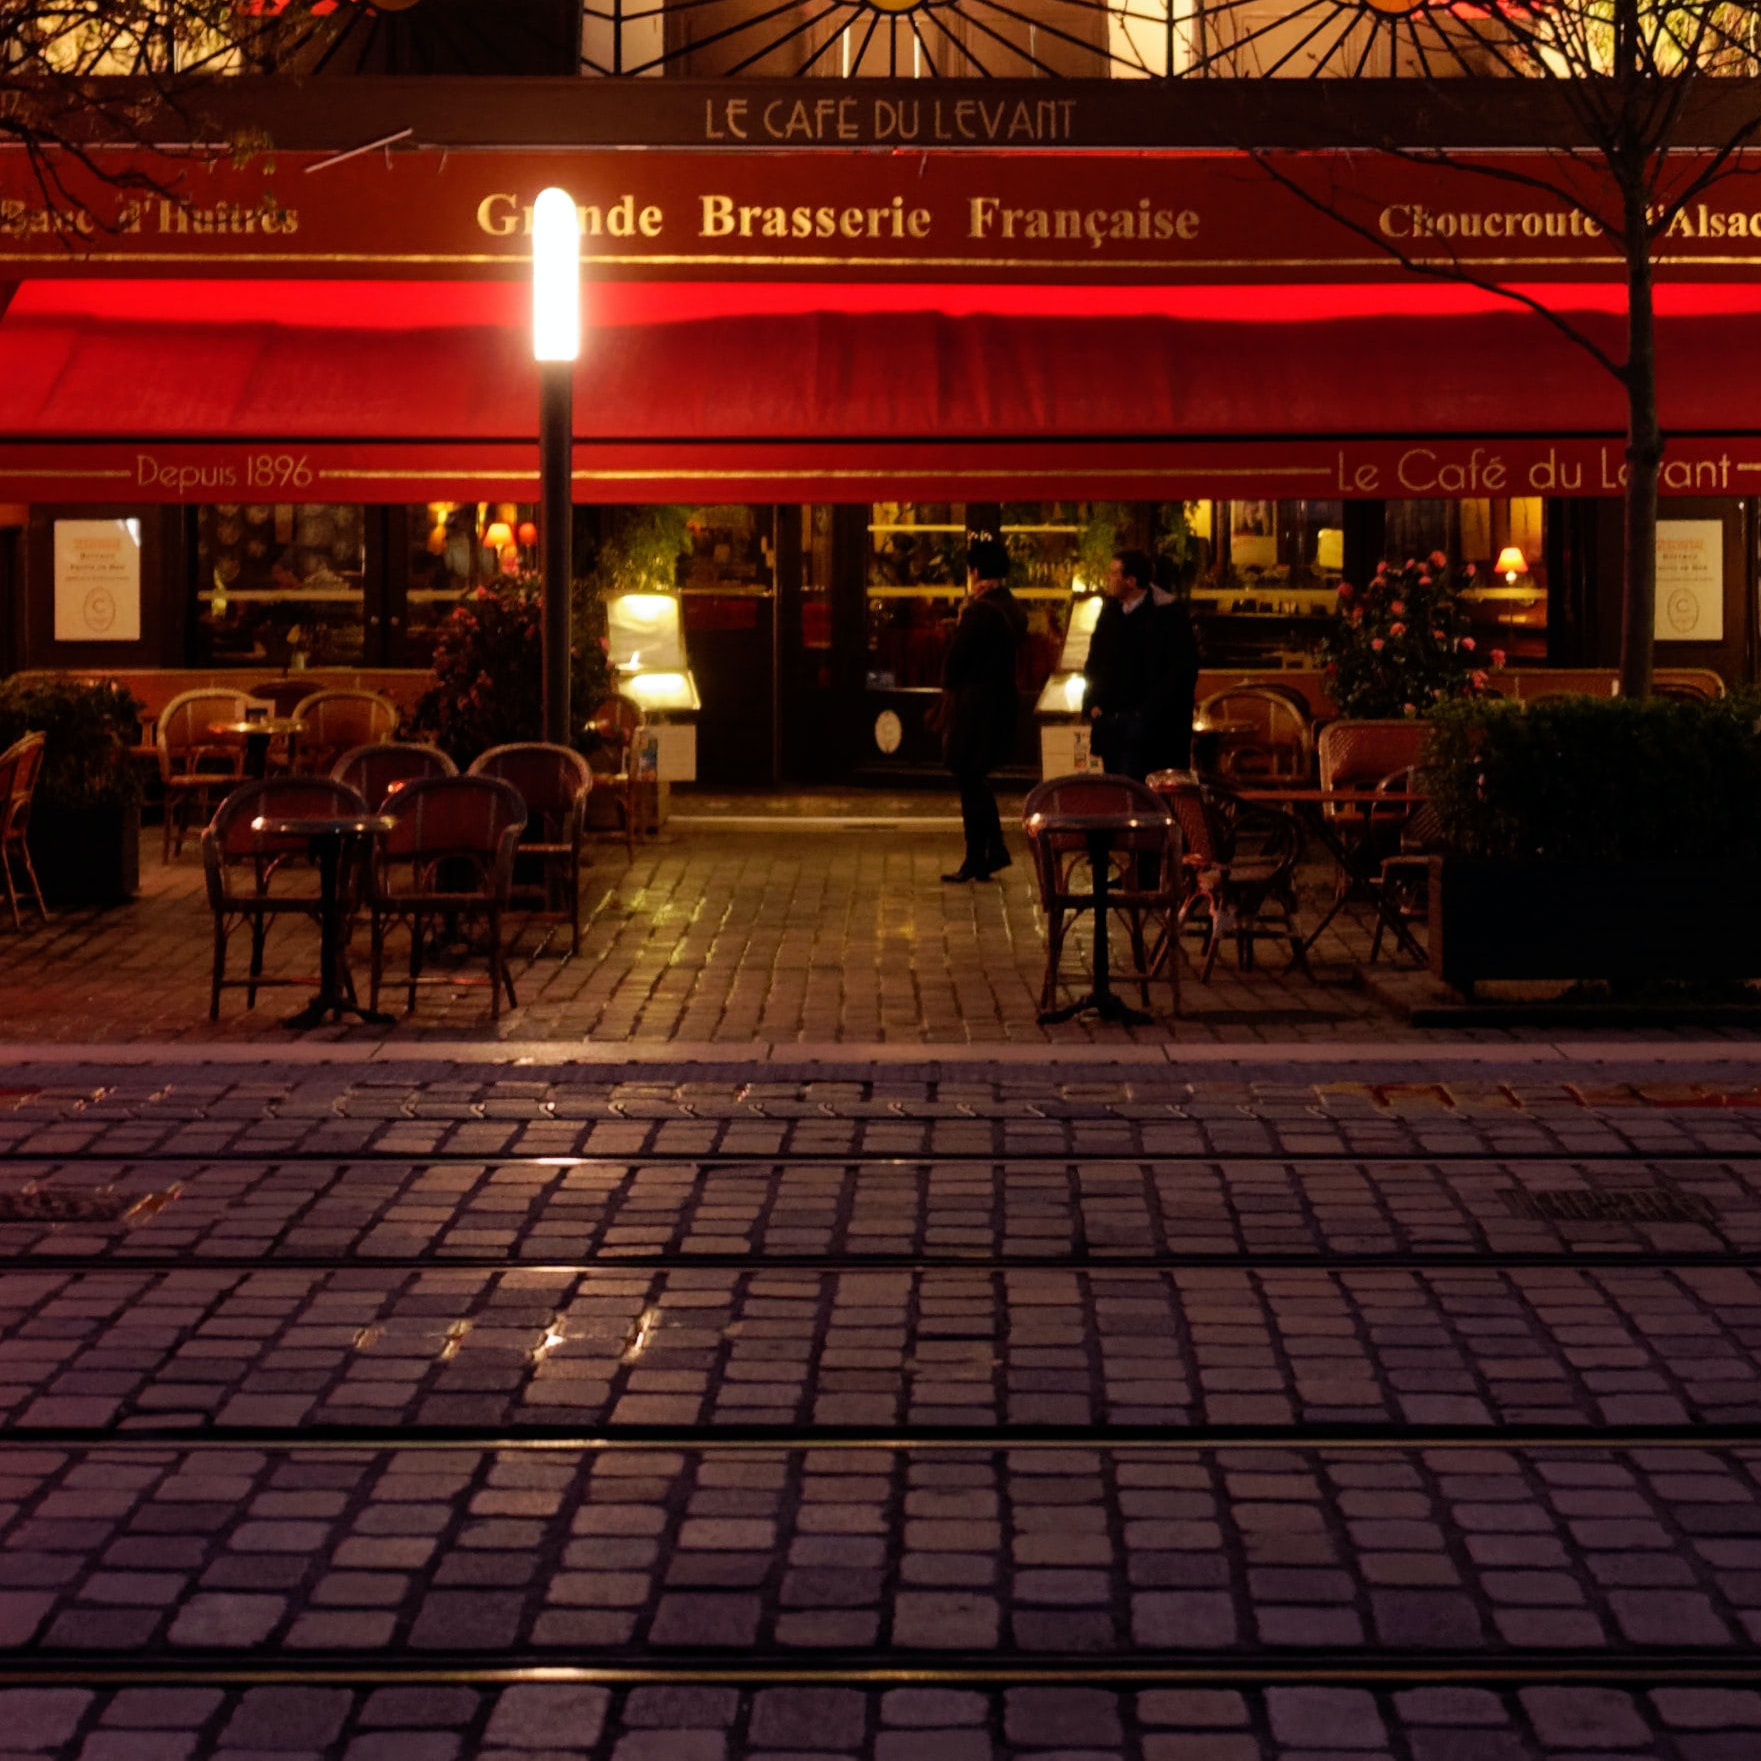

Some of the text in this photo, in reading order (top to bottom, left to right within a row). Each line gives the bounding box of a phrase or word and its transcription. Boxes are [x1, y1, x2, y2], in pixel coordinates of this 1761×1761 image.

[705, 96, 1077, 139] LE CAFÉ DU LEVANT
[698, 194, 932, 237] Brasserie
[966, 196, 1201, 249] Française
[1379, 203, 1603, 239] Choucroute
[137, 454, 313, 495] Depuis 1896
[1338, 450, 1379, 491] Le
[1397, 448, 1506, 492] Café
[1528, 448, 1582, 490] du
